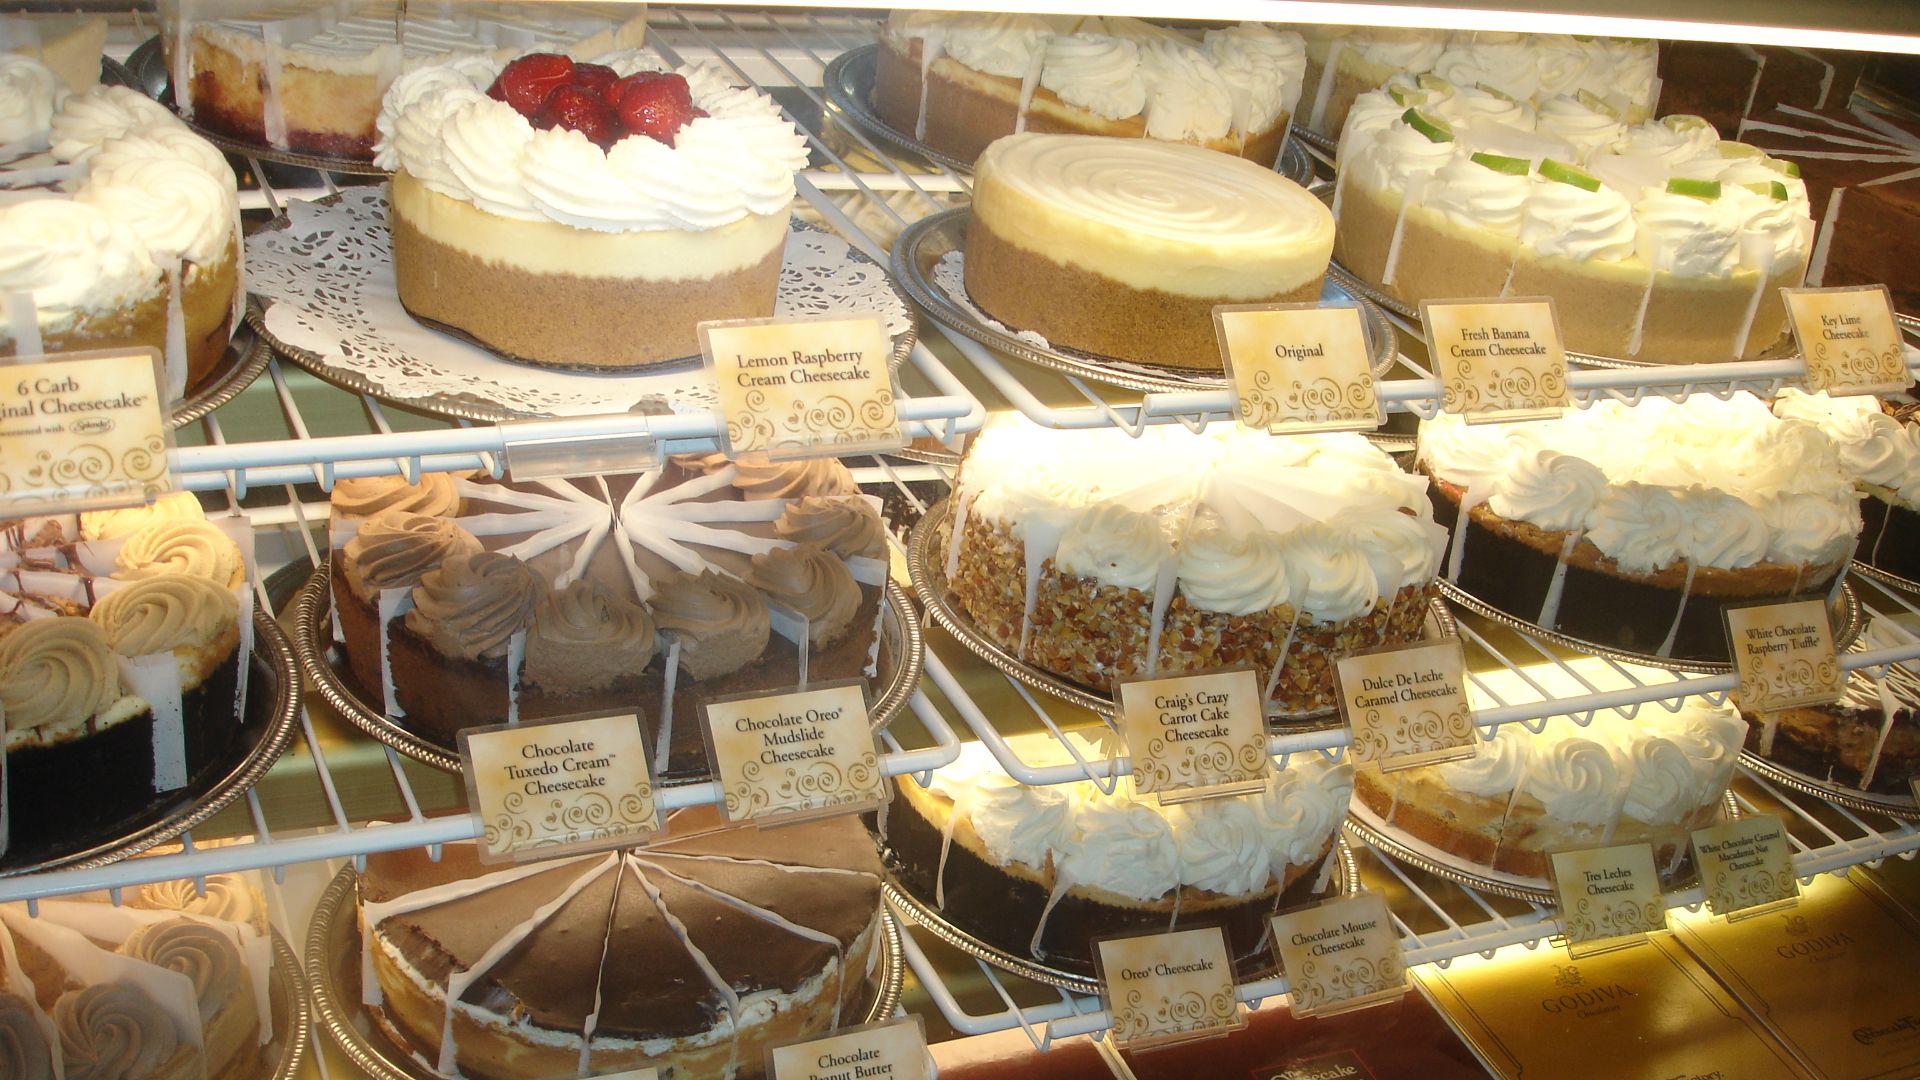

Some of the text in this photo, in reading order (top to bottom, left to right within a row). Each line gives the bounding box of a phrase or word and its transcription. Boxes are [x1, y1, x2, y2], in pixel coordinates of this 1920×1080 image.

[1821, 314, 1861, 329] Key Lime
[1461, 327, 1531, 341] Fresh Banana
[1822, 328, 1870, 340] Cheesecake
[736, 348, 864, 369] Lemon Raspberry
[1275, 343, 1324, 361] Original
[1450, 342, 1547, 358] Cream Cheesecake
[17, 376, 80, 396] 6 Carb
[737, 366, 871, 389] Cream Cheesecake
[0, 400, 35, 421] inal
[1745, 622, 1816, 640] White Chocolate
[1746, 641, 1788, 657] Raspberry
[1362, 669, 1444, 692] Dulce De Leche
[1154, 691, 1229, 711] Craig's Crazy
[1355, 683, 1457, 709] Caramel Cheesecake
[735, 713, 802, 733] Chocolate
[1159, 707, 1230, 726] Carrot Cake
[763, 727, 825, 747] Mudslide
[1165, 724, 1230, 743] Cheesecake
[521, 739, 595, 759] Chocolate
[760, 744, 835, 765] Cheesecake
[504, 761, 559, 780] Tuxedo
[524, 774, 606, 796] Cheesecake
[1583, 867, 1632, 882] Tres Leches
[1587, 881, 1635, 896] Cheesecake
[1291, 920, 1377, 946] Chocolate Mousse
[1312, 936, 1365, 957] Cheesecake
[1777, 932, 1855, 959] GODIVA
[1155, 958, 1214, 976] Cheesecake
[1542, 983, 1634, 1014] GODIVA
[818, 1048, 880, 1068] Chocolate
[854, 1063, 893, 1079] Butter
